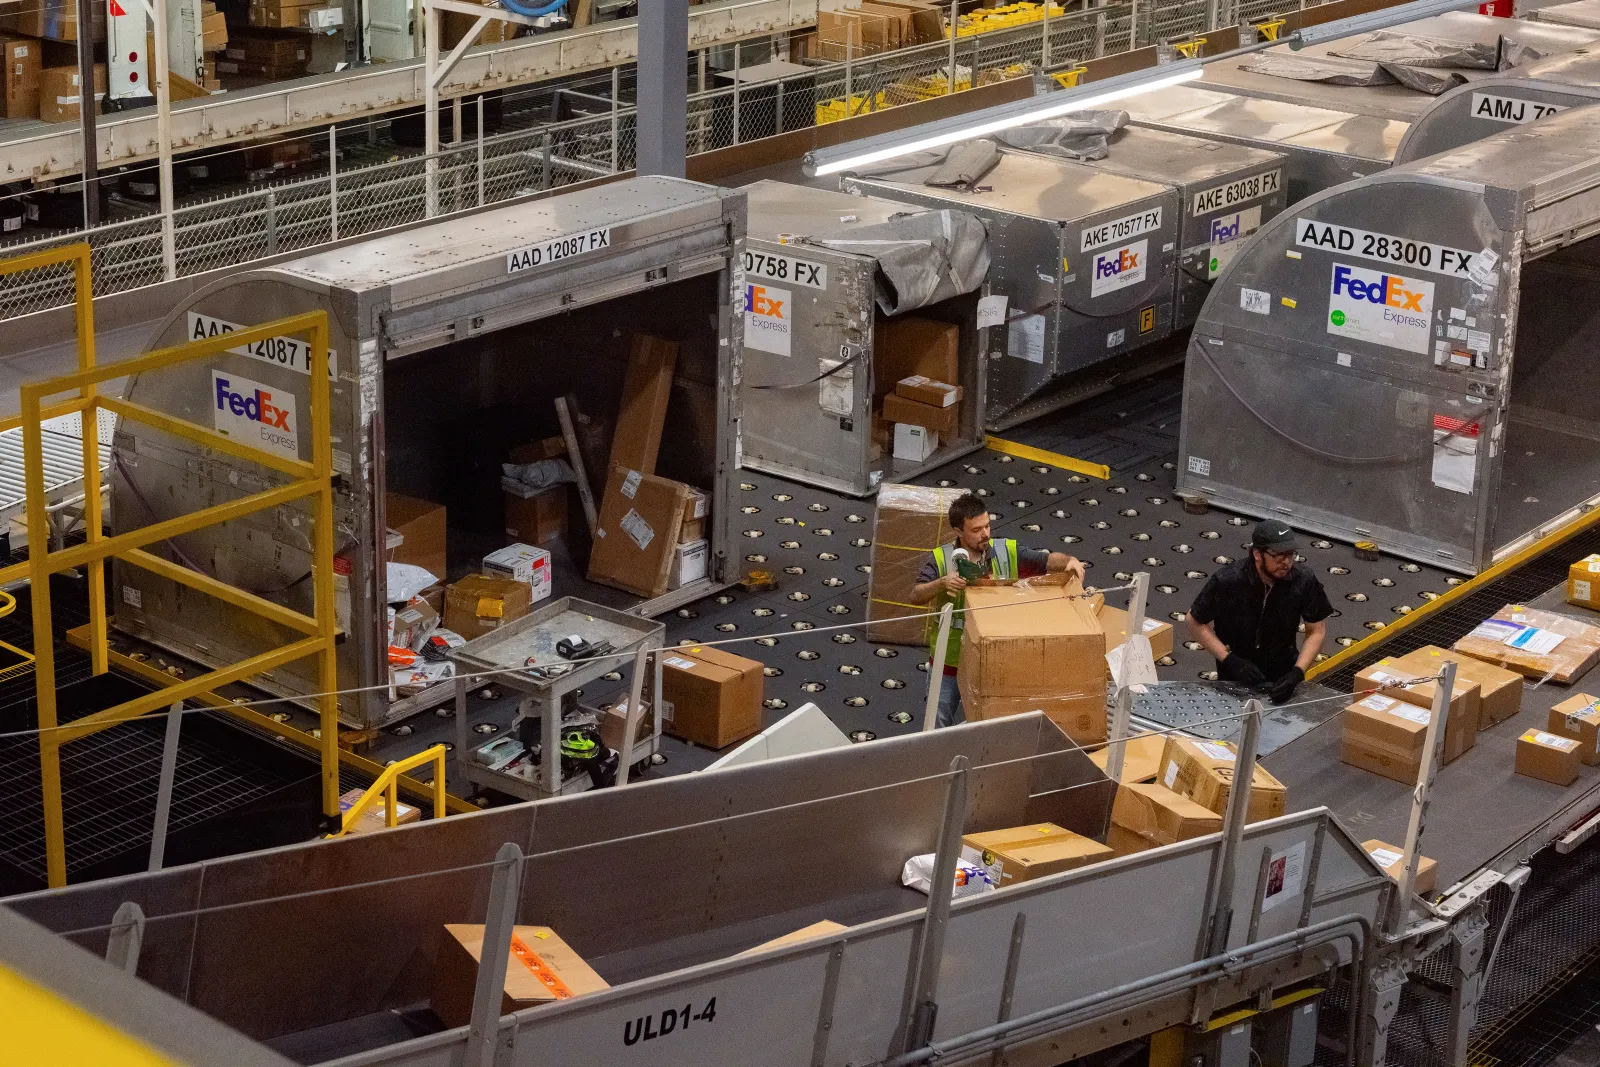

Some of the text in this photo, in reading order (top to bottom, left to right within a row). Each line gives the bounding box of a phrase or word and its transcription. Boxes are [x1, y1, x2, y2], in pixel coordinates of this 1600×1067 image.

[1477, 97, 1525, 120] AMJ
[1196, 172, 1277, 212] AKE 63038 FX
[1084, 212, 1158, 248] AKE 70577 FX
[1212, 214, 1240, 244] Fed
[510, 230, 608, 272] AAD 12087 FX
[1301, 224, 1354, 251] AAD
[1362, 234, 1431, 266] 28300
[1440, 249, 1472, 273] FX
[794, 262, 820, 286] FX
[1096, 249, 1138, 280] FedEx
[1333, 266, 1425, 313] FedEx
[752, 316, 788, 334] Express
[1144, 312, 1150, 328] F
[1383, 309, 1427, 328] Express
[216, 378, 290, 432] FedEx
[261, 427, 296, 450] Express
[624, 996, 716, 1046] ULD1-4
